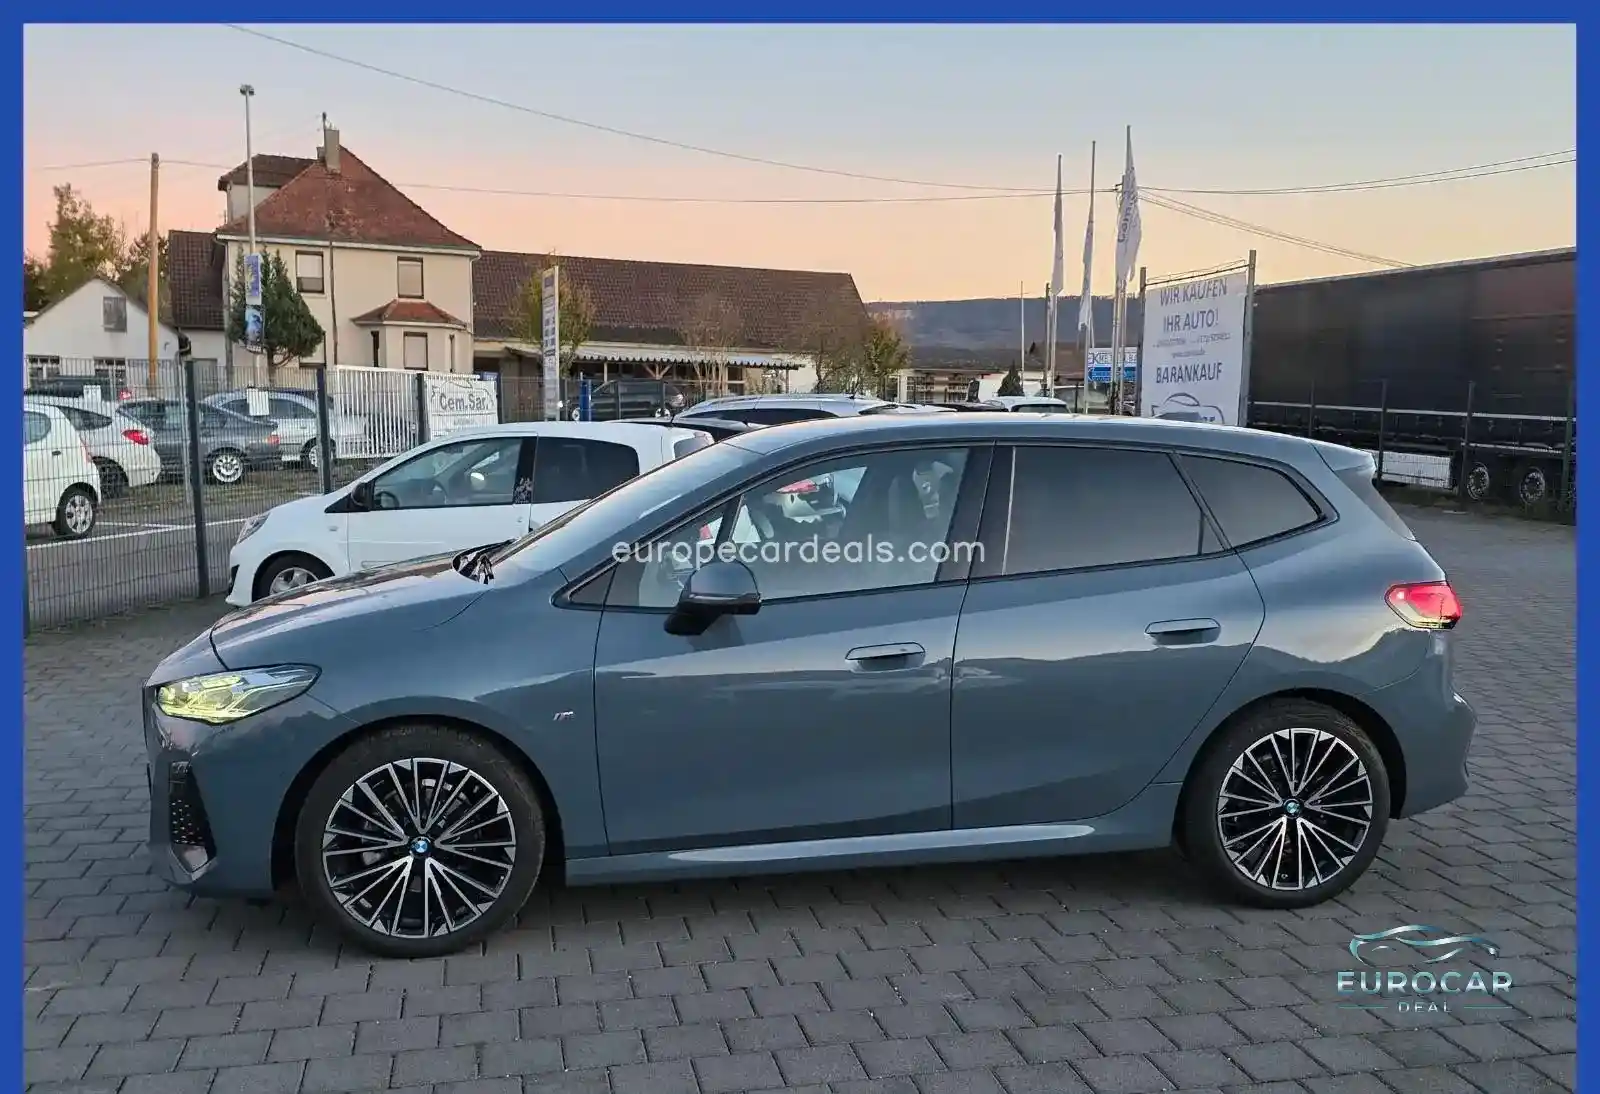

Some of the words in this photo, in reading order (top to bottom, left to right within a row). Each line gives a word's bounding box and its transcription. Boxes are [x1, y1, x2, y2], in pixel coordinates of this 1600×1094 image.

[1160, 285, 1179, 306] WIR
[1182, 278, 1227, 302] KAUFEN
[1163, 314, 1180, 333] IHR
[1183, 307, 1219, 331] AUTO!
[1156, 362, 1223, 384] BARANKAUF
